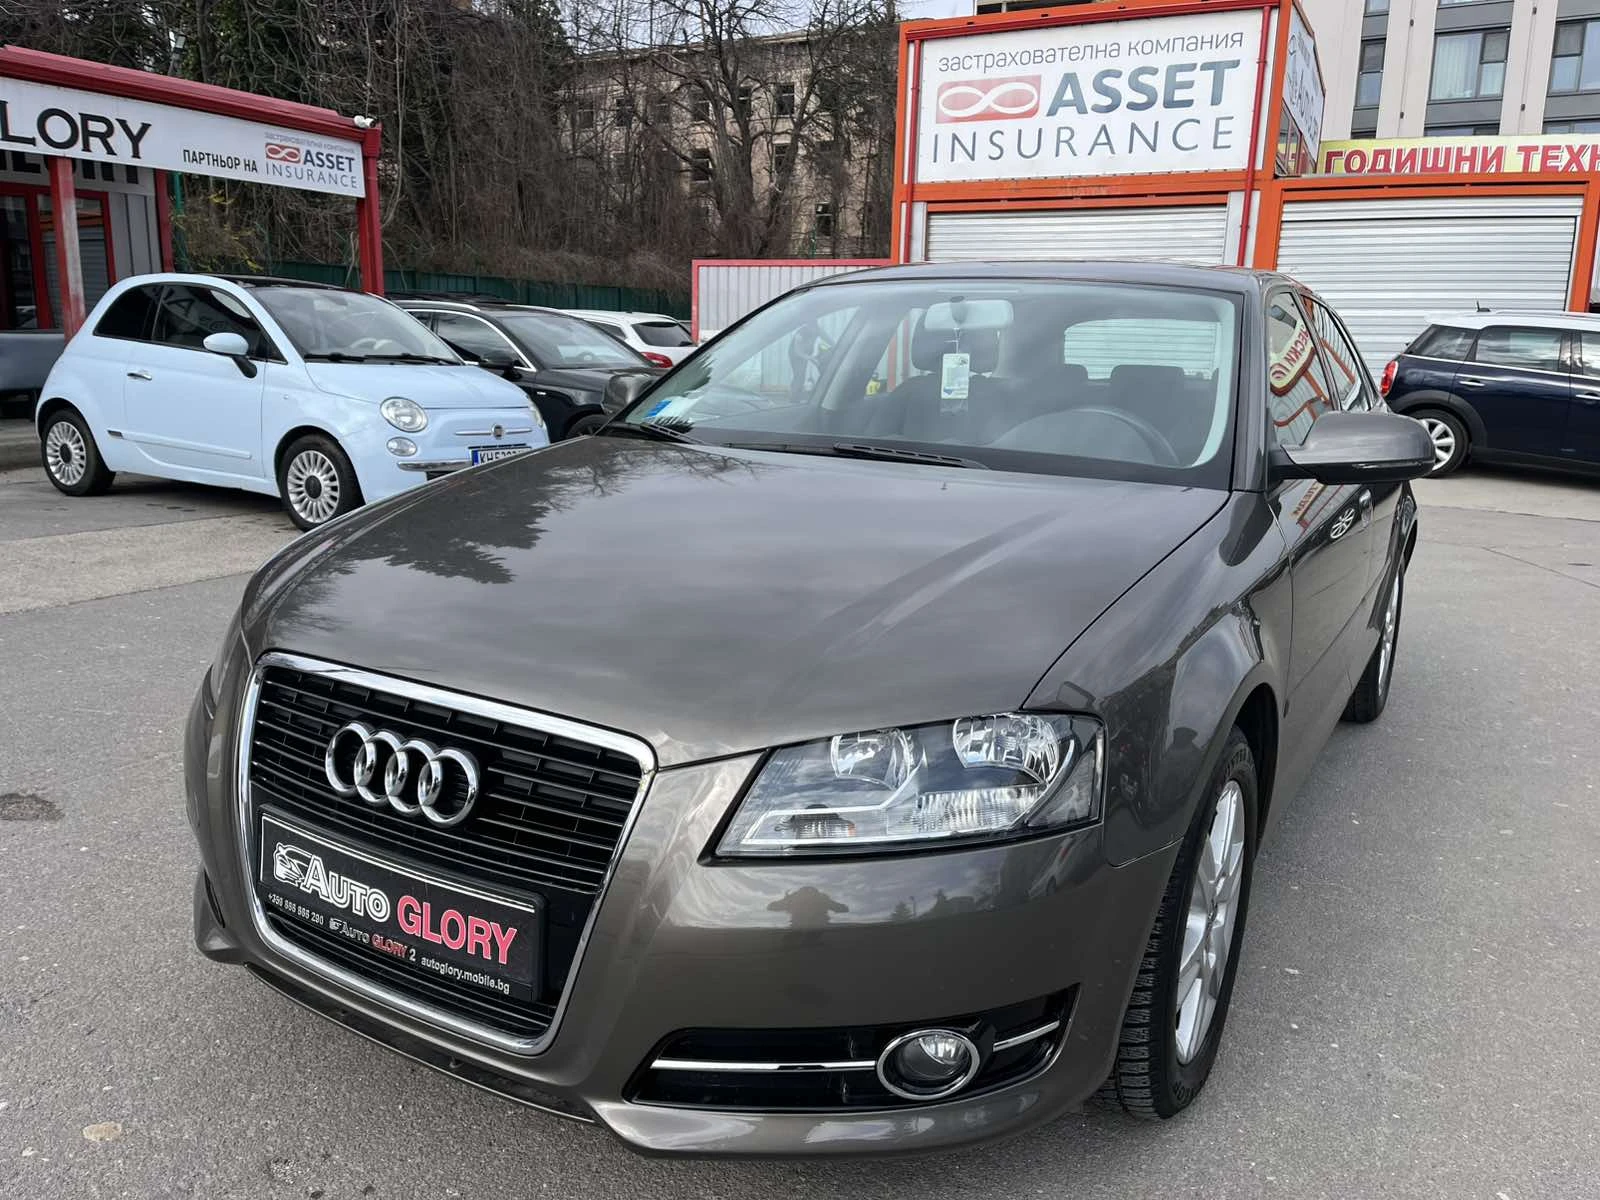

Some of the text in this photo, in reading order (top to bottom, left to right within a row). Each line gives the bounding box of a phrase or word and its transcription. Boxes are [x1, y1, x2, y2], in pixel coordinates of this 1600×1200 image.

[938, 31, 1244, 73] застрахователна компания
[1046, 59, 1240, 117] ASSET
[933, 116, 1235, 163] INSURANCE
[1325, 145, 1504, 174] ГОДИШНИ
[182, 149, 258, 173] ПАРТНЬОР НА
[265, 162, 358, 189] INSURANCE
[303, 149, 355, 173] ASSET
[397, 895, 518, 965] GLORY
[311, 912, 324, 925] 290
[371, 933, 408, 959] GLORY
[409, 948, 416, 962] 2
[421, 957, 510, 995] autoglory.mobile.bg
